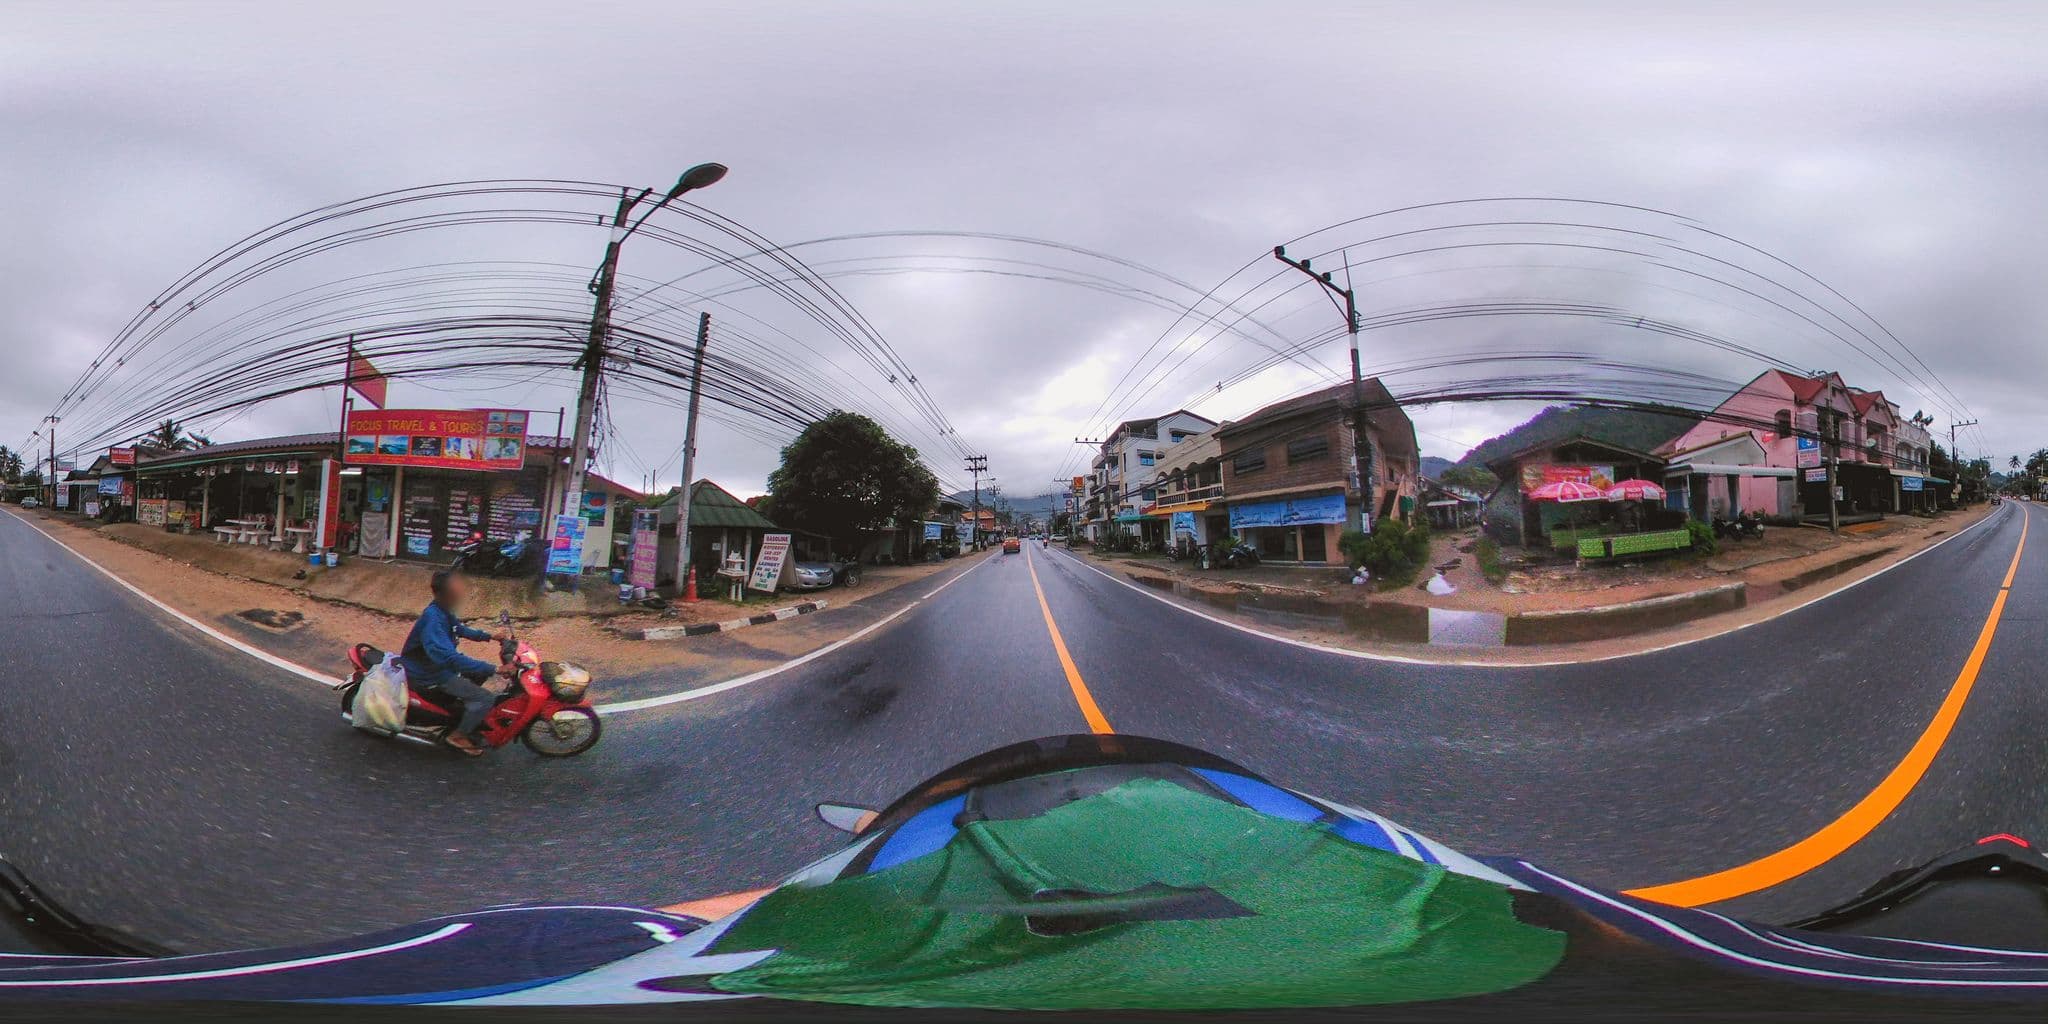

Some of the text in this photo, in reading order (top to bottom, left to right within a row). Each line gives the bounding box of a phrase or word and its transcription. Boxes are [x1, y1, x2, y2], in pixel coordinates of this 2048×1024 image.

[350, 419, 382, 432] FOCUS
[387, 419, 425, 432] TRAVEL
[429, 421, 437, 432] &
